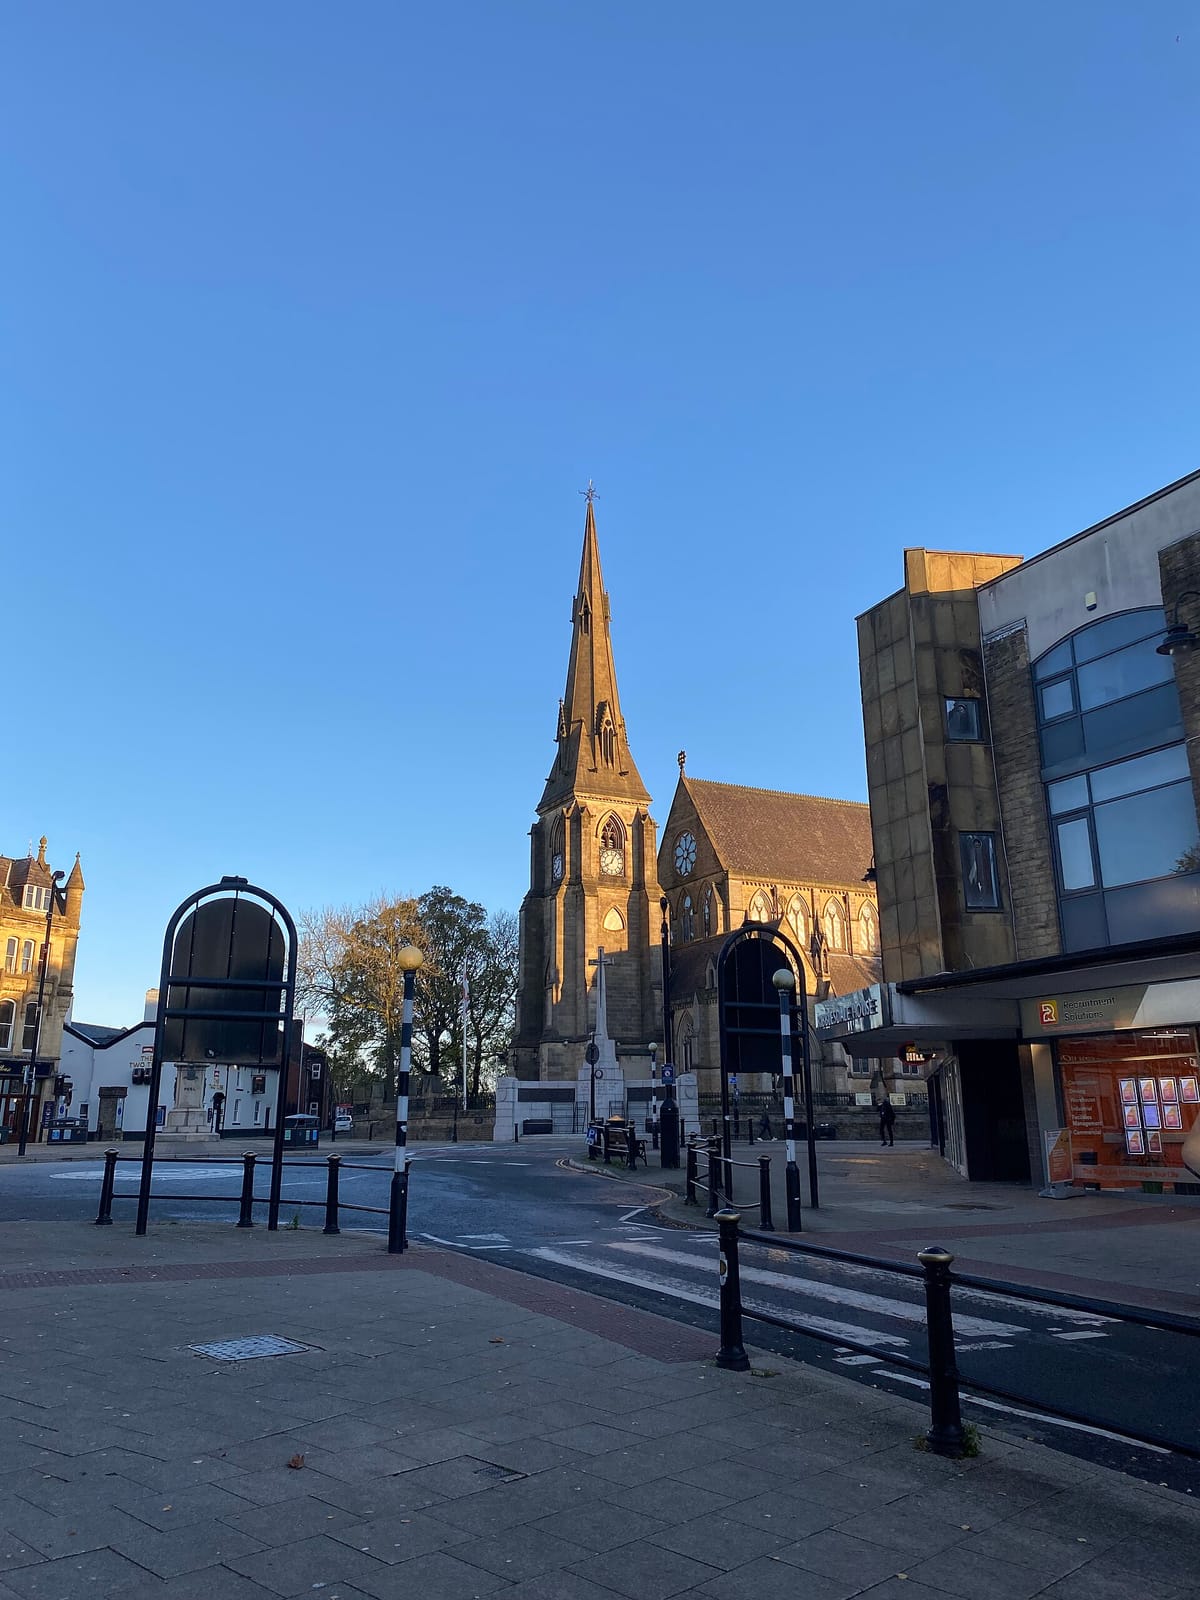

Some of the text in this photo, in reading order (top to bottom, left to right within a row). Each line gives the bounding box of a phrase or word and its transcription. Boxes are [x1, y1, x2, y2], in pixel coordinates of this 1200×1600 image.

[1064, 997, 1116, 1010] Recruitment
[853, 999, 879, 1020] HOUSE
[1064, 1011, 1104, 1022] Solutions
[905, 1052, 925, 1062] HILL
[589, 1129, 596, 1138] P
